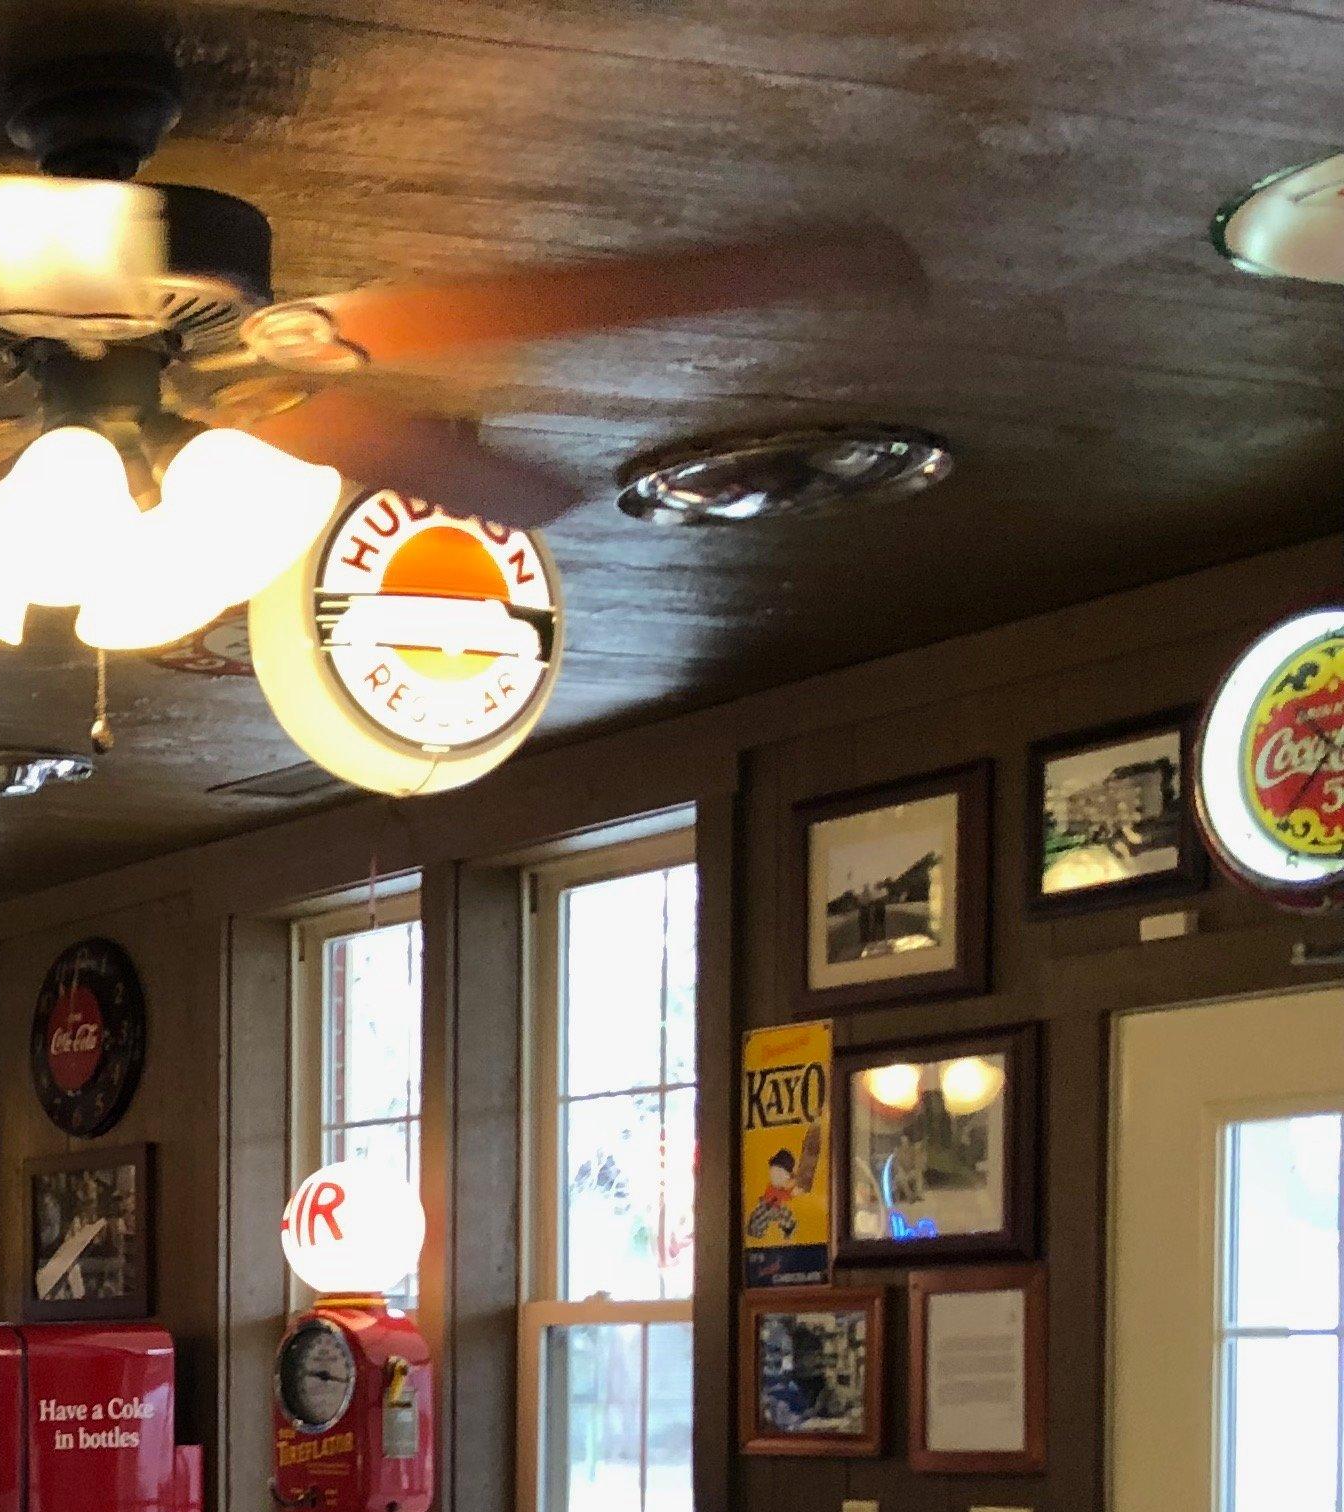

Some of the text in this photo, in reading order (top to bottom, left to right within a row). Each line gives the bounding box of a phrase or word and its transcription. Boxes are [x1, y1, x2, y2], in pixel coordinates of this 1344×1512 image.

[341, 492, 535, 585] HUDON
[746, 1062, 826, 1130] KAYO
[39, 1397, 155, 1421] Have a Coke
[55, 1426, 140, 1450] in bottles
